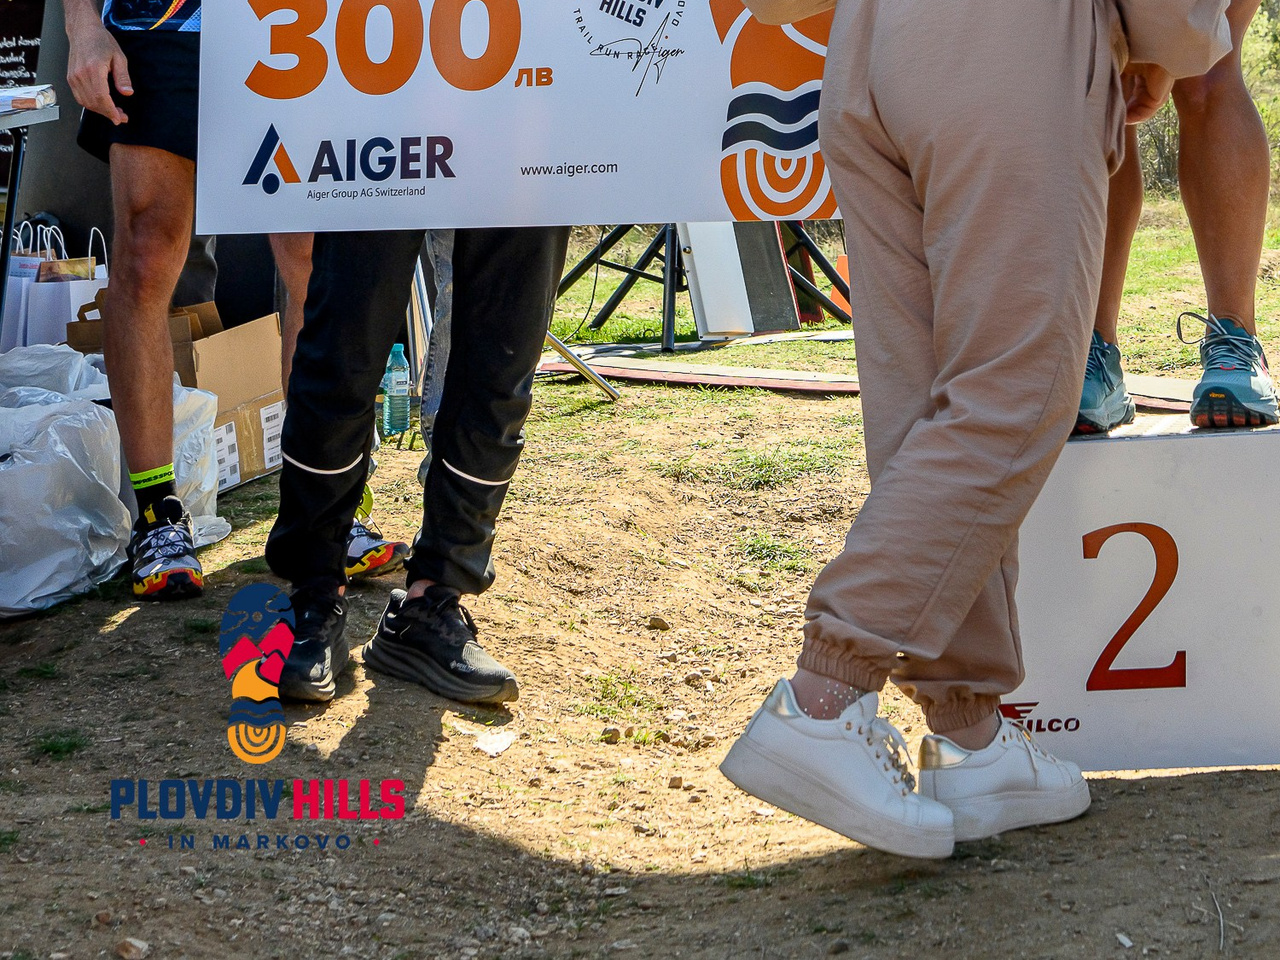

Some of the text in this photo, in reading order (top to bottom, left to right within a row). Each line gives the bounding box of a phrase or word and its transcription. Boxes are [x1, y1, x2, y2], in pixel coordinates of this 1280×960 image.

[573, 7, 594, 45] TRAIL
[514, 65, 554, 88] лв
[307, 135, 457, 183] AIGER
[520, 160, 619, 178] www.aiger.com
[306, 186, 427, 202] Aiger Group AG Switzerland
[1081, 521, 1187, 692] 2
